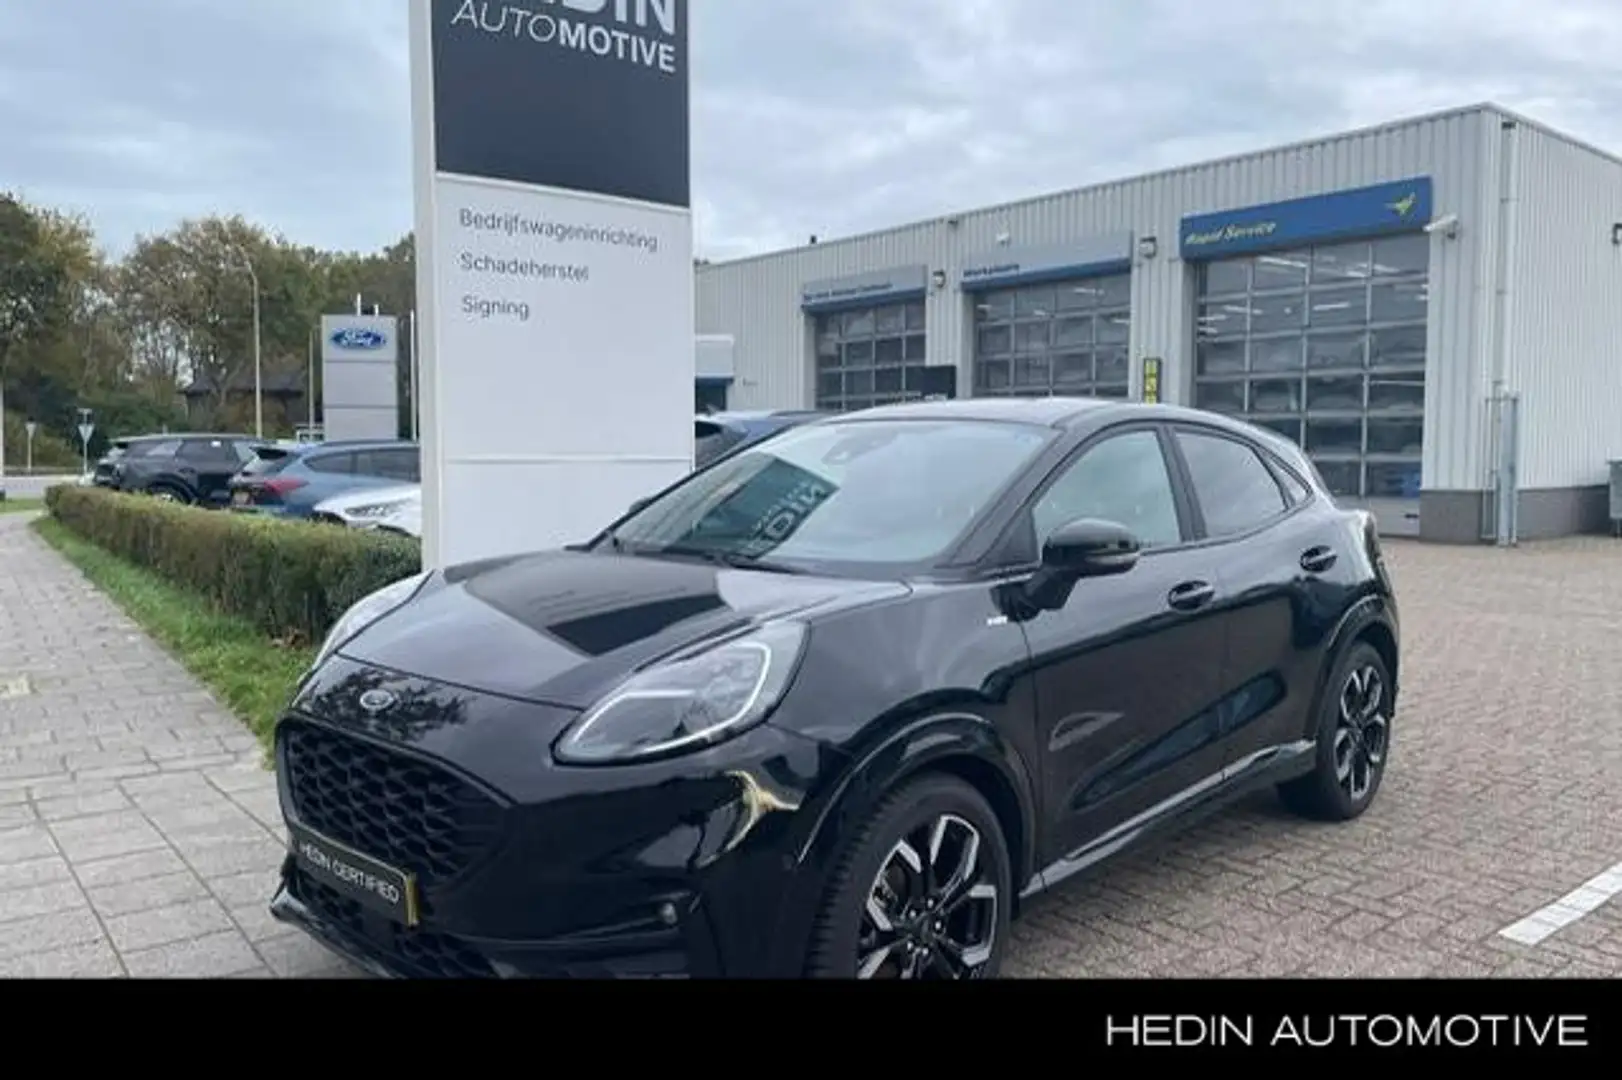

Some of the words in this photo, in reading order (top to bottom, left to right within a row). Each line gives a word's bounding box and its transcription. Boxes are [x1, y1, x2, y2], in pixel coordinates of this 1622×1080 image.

[451, 0, 676, 73] AUTOMOTIVE
[459, 208, 658, 252] Bedrijfswageninrichting
[460, 252, 589, 281] Schadeherstel
[461, 295, 529, 321] Signing
[332, 859, 400, 905] CERTIFIED
